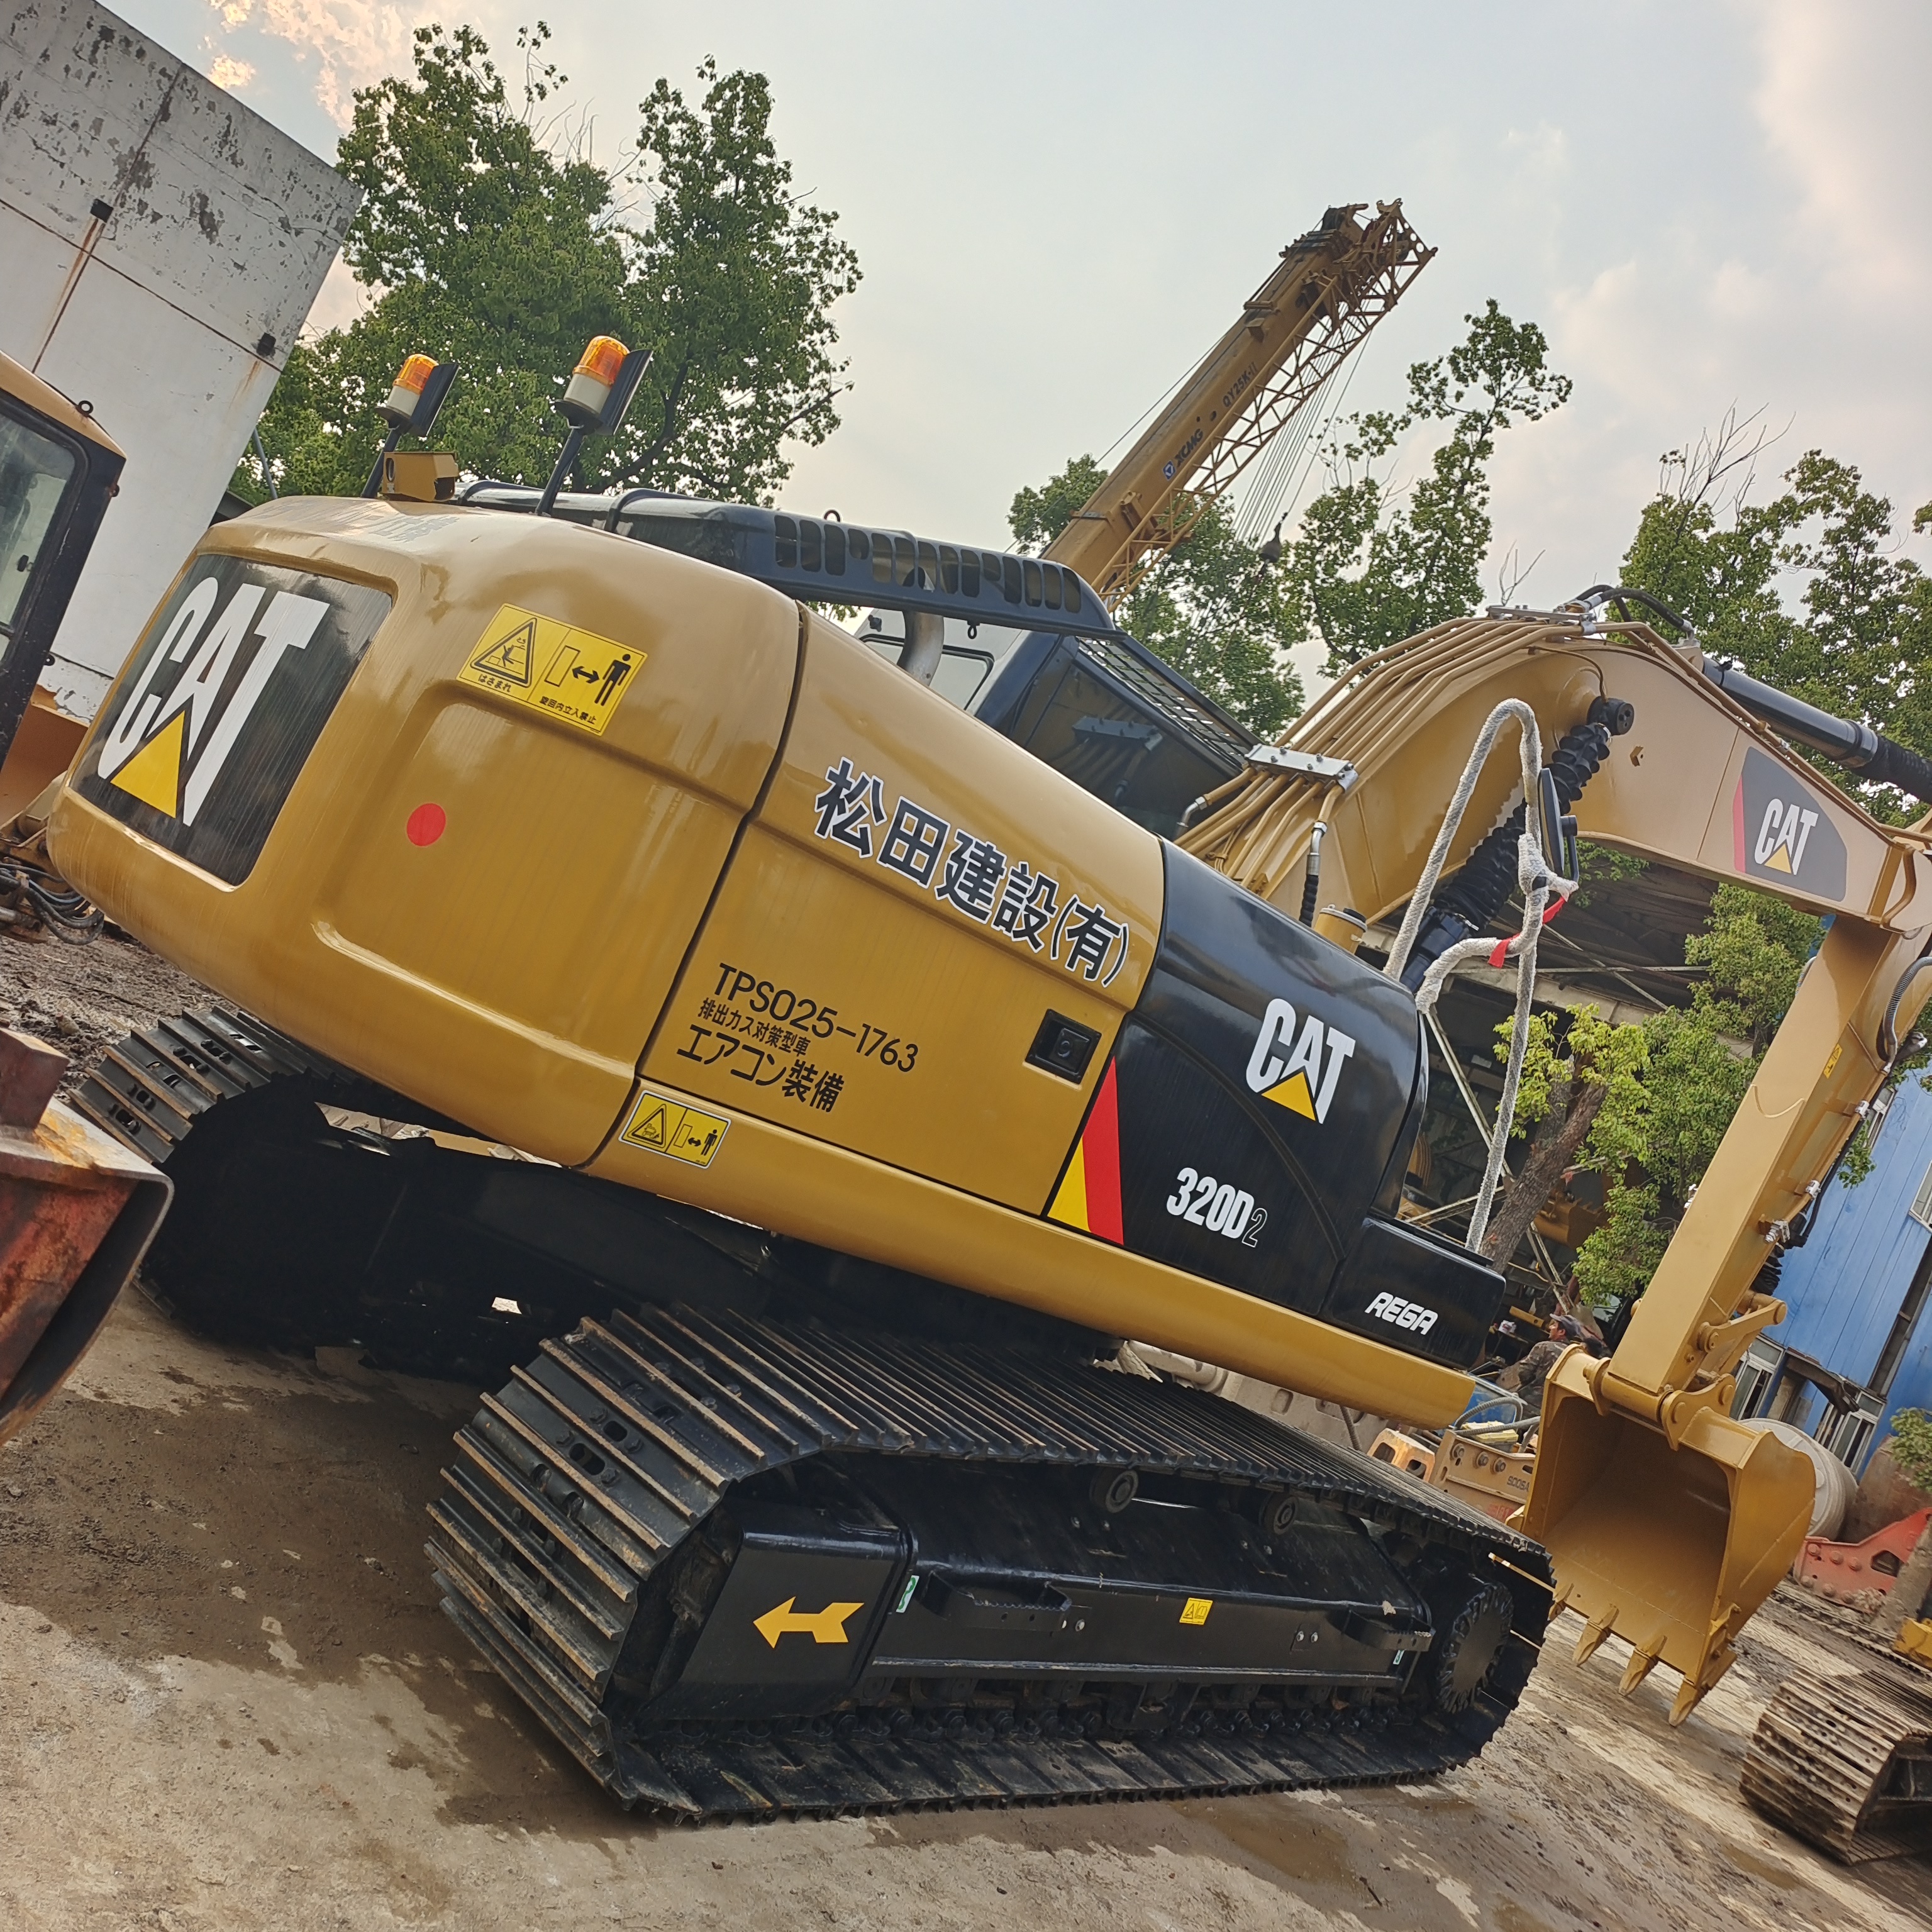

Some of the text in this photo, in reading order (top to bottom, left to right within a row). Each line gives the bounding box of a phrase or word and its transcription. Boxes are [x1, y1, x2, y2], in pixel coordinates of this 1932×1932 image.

[1175, 428, 1204, 467] XCMG
[97, 577, 330, 827] CAT
[478, 674, 511, 692] はさまれ
[1754, 798, 1819, 875] CAT
[714, 963, 918, 1072] TPS025-1763
[676, 1024, 845, 1113] エアコン装備
[1246, 998, 1356, 1124] CAT
[1365, 1292, 1438, 1335] REGA
